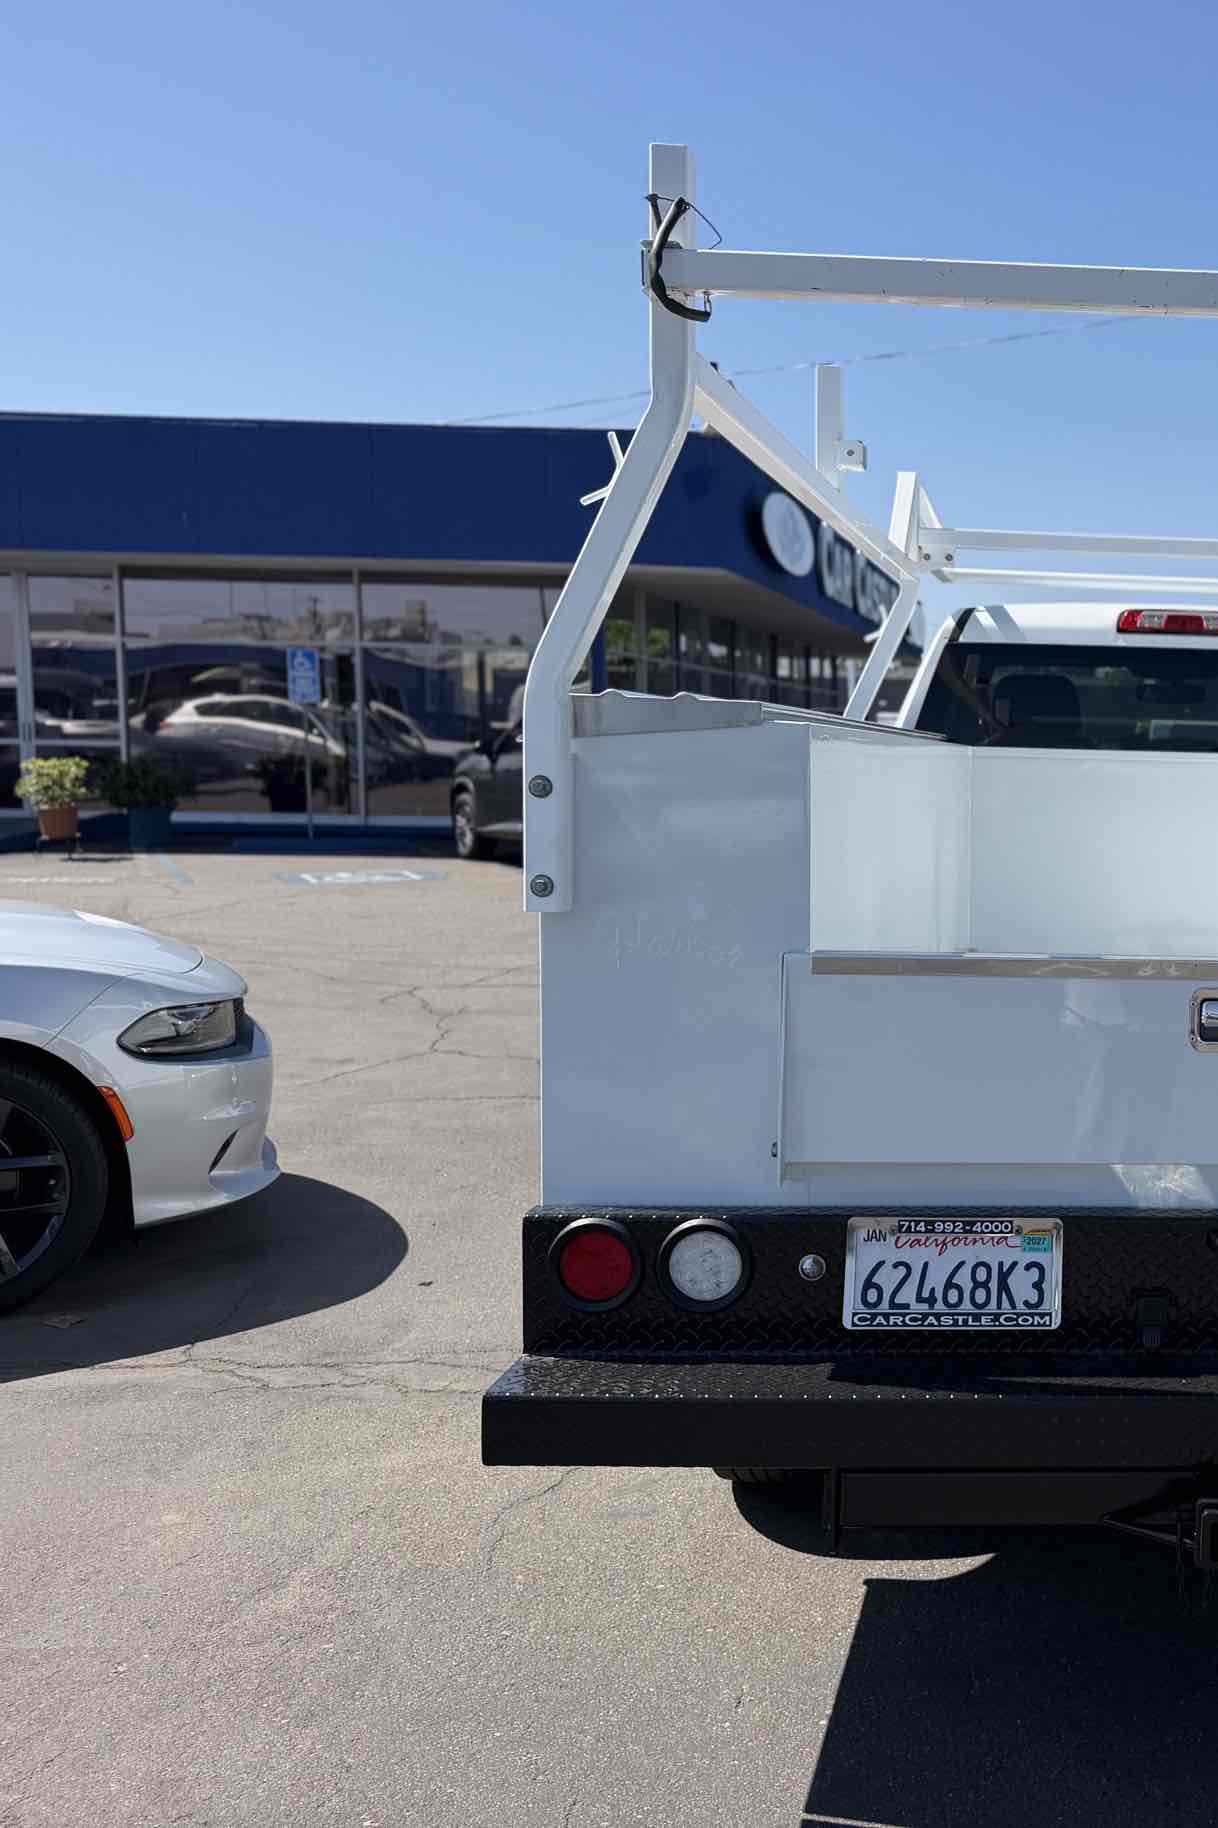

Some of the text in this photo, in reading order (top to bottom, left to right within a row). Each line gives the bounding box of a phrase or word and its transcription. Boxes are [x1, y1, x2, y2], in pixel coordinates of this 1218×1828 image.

[899, 1220, 1013, 1234] 714-992-4000
[863, 1229, 887, 1243] JAN
[860, 1259, 1047, 1311] 62468K3
